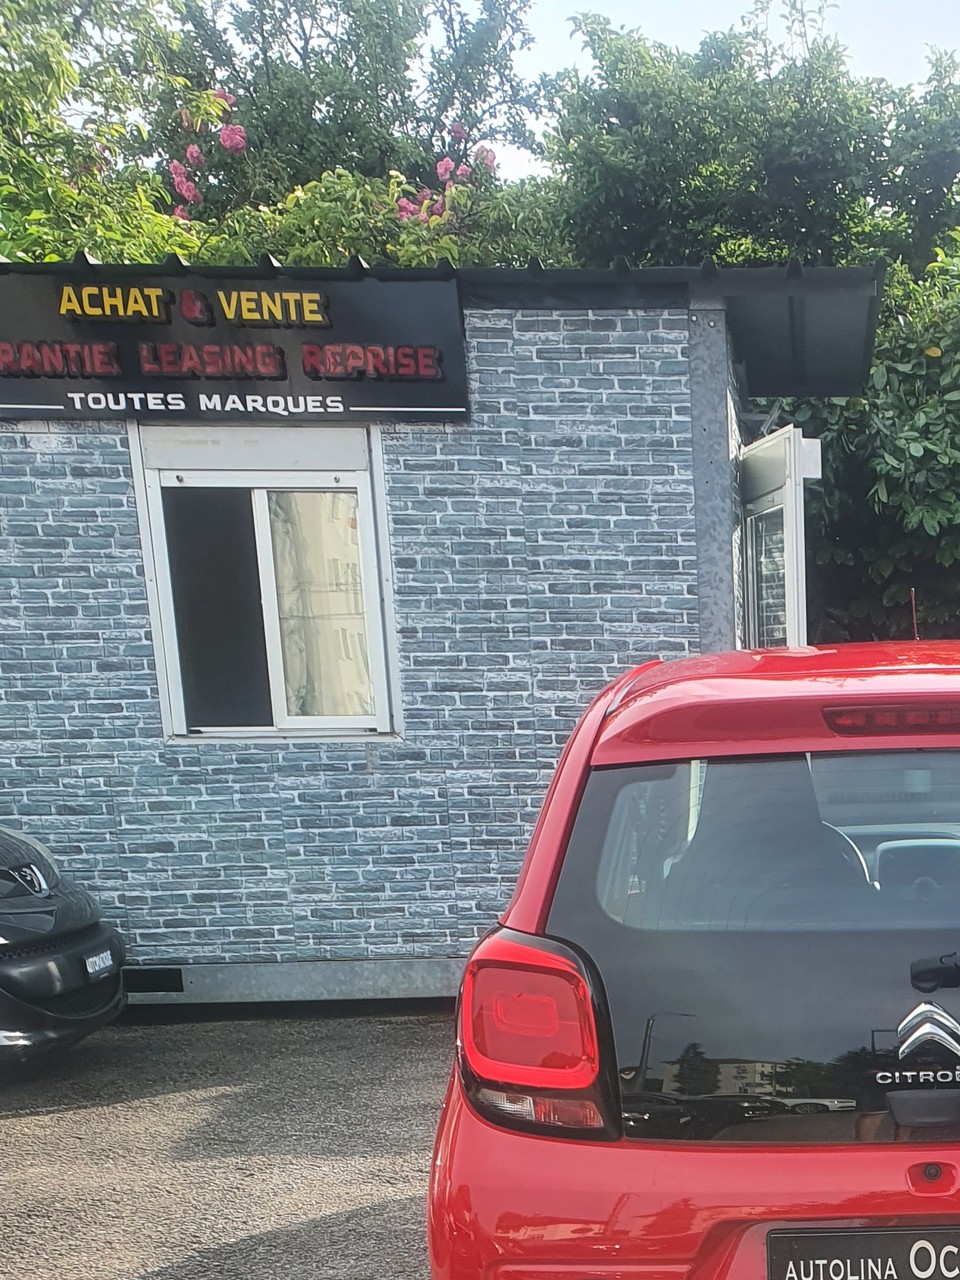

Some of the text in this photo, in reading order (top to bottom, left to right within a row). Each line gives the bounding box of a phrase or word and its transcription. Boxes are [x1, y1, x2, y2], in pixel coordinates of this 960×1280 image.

[59, 286, 324, 322] ACHAT & VENTE
[140, 342, 278, 376] LEASING
[303, 345, 440, 377] REPRISE
[67, 392, 345, 416] TOUTES MARQUES
